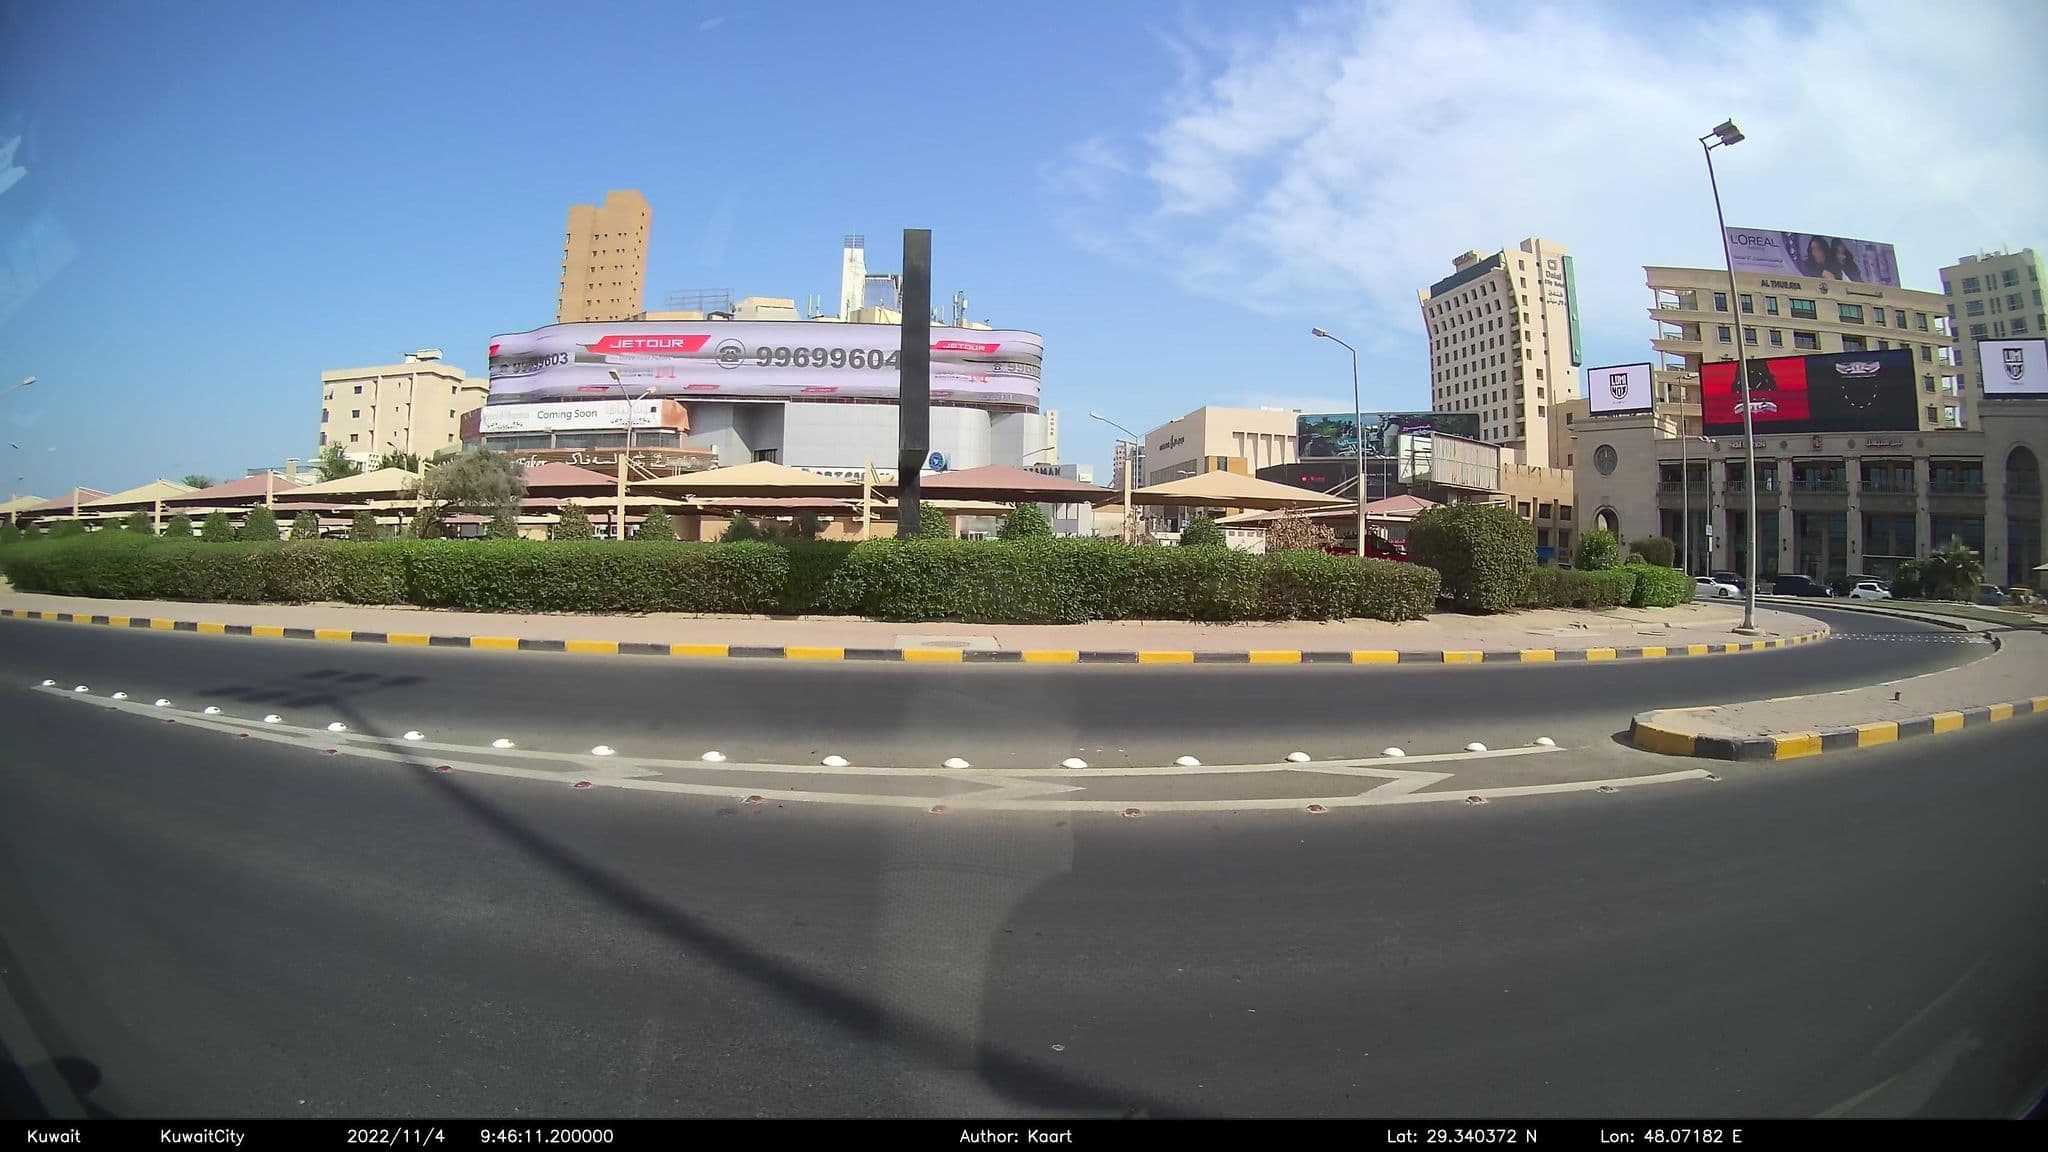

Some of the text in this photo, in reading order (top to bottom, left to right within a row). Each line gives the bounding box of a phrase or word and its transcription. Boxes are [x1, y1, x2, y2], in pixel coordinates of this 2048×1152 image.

[1761, 279, 1770, 287] AL
[609, 339, 684, 349] JETOUR
[943, 343, 986, 352] JETOUR
[756, 346, 901, 370] 99699604
[537, 410, 572, 420] Coming
[574, 409, 598, 419] Soon
